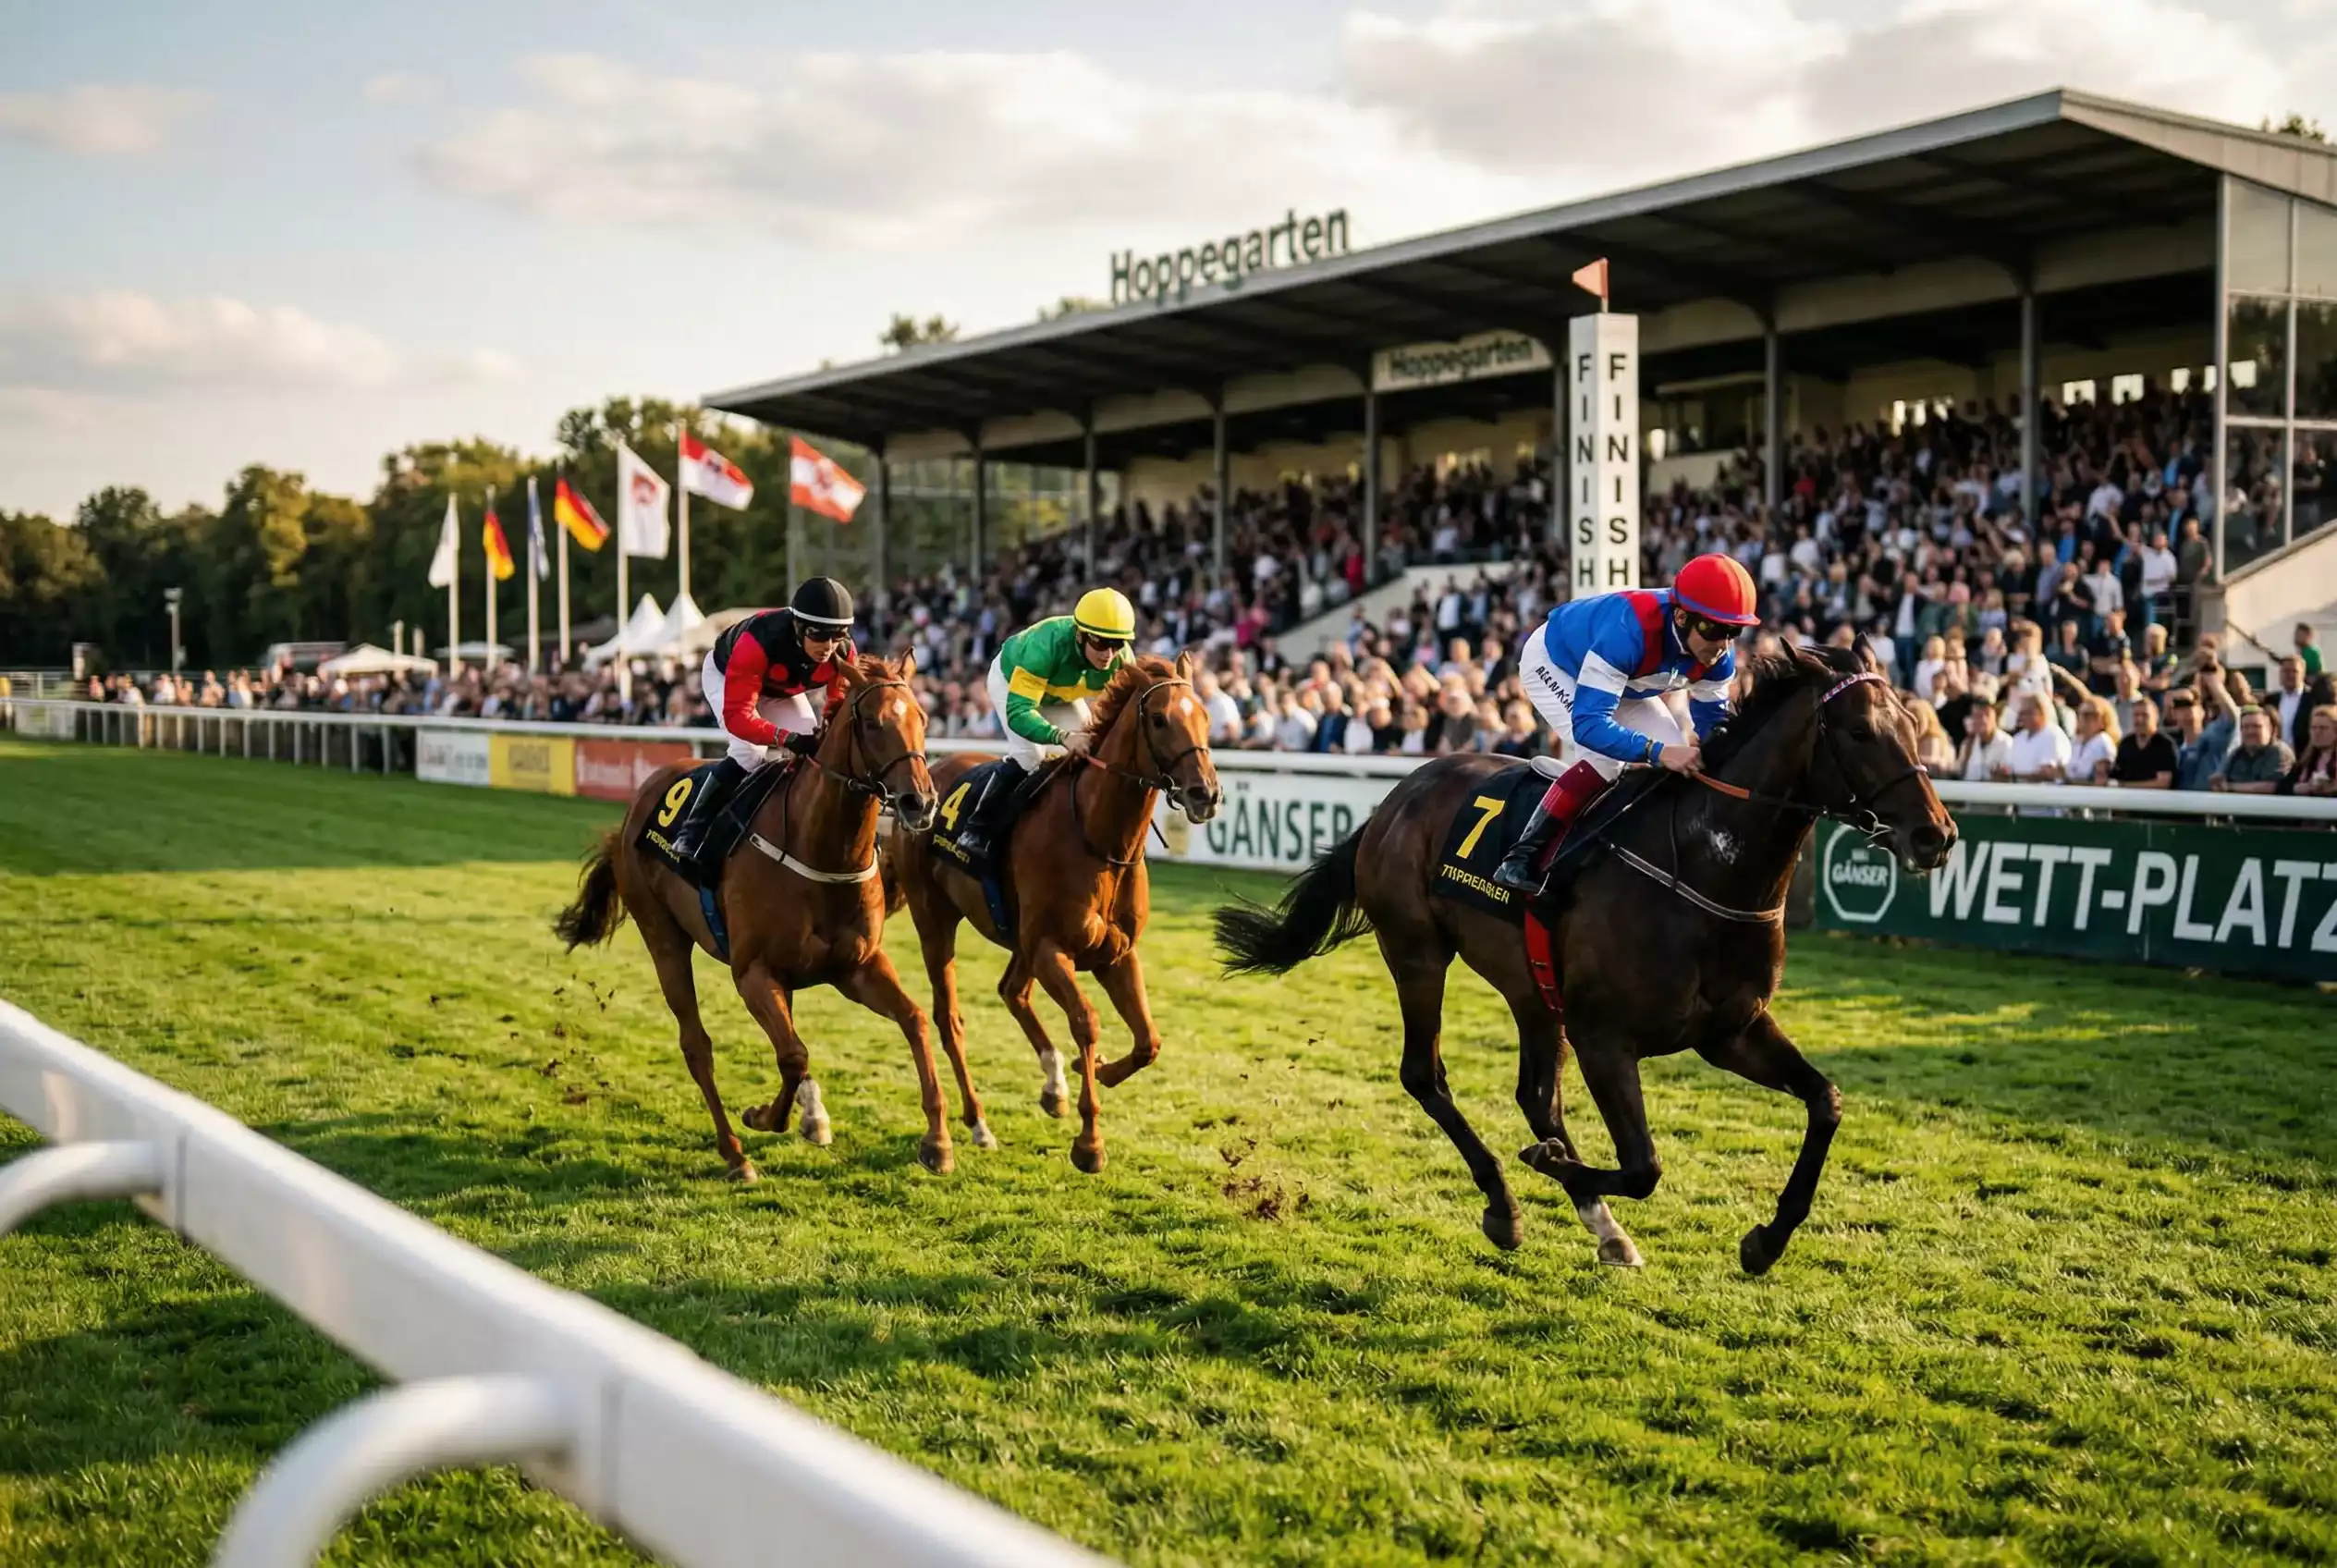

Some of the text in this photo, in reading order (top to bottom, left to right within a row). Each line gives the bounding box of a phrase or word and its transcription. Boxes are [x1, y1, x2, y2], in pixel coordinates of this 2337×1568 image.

[1111, 208, 1347, 306] Hoppegarten
[1577, 354, 1595, 587] FINISH
[1609, 354, 1630, 586] FINISH
[657, 778, 693, 827] 9
[940, 783, 972, 831] 4
[1455, 795, 1506, 859] 7
